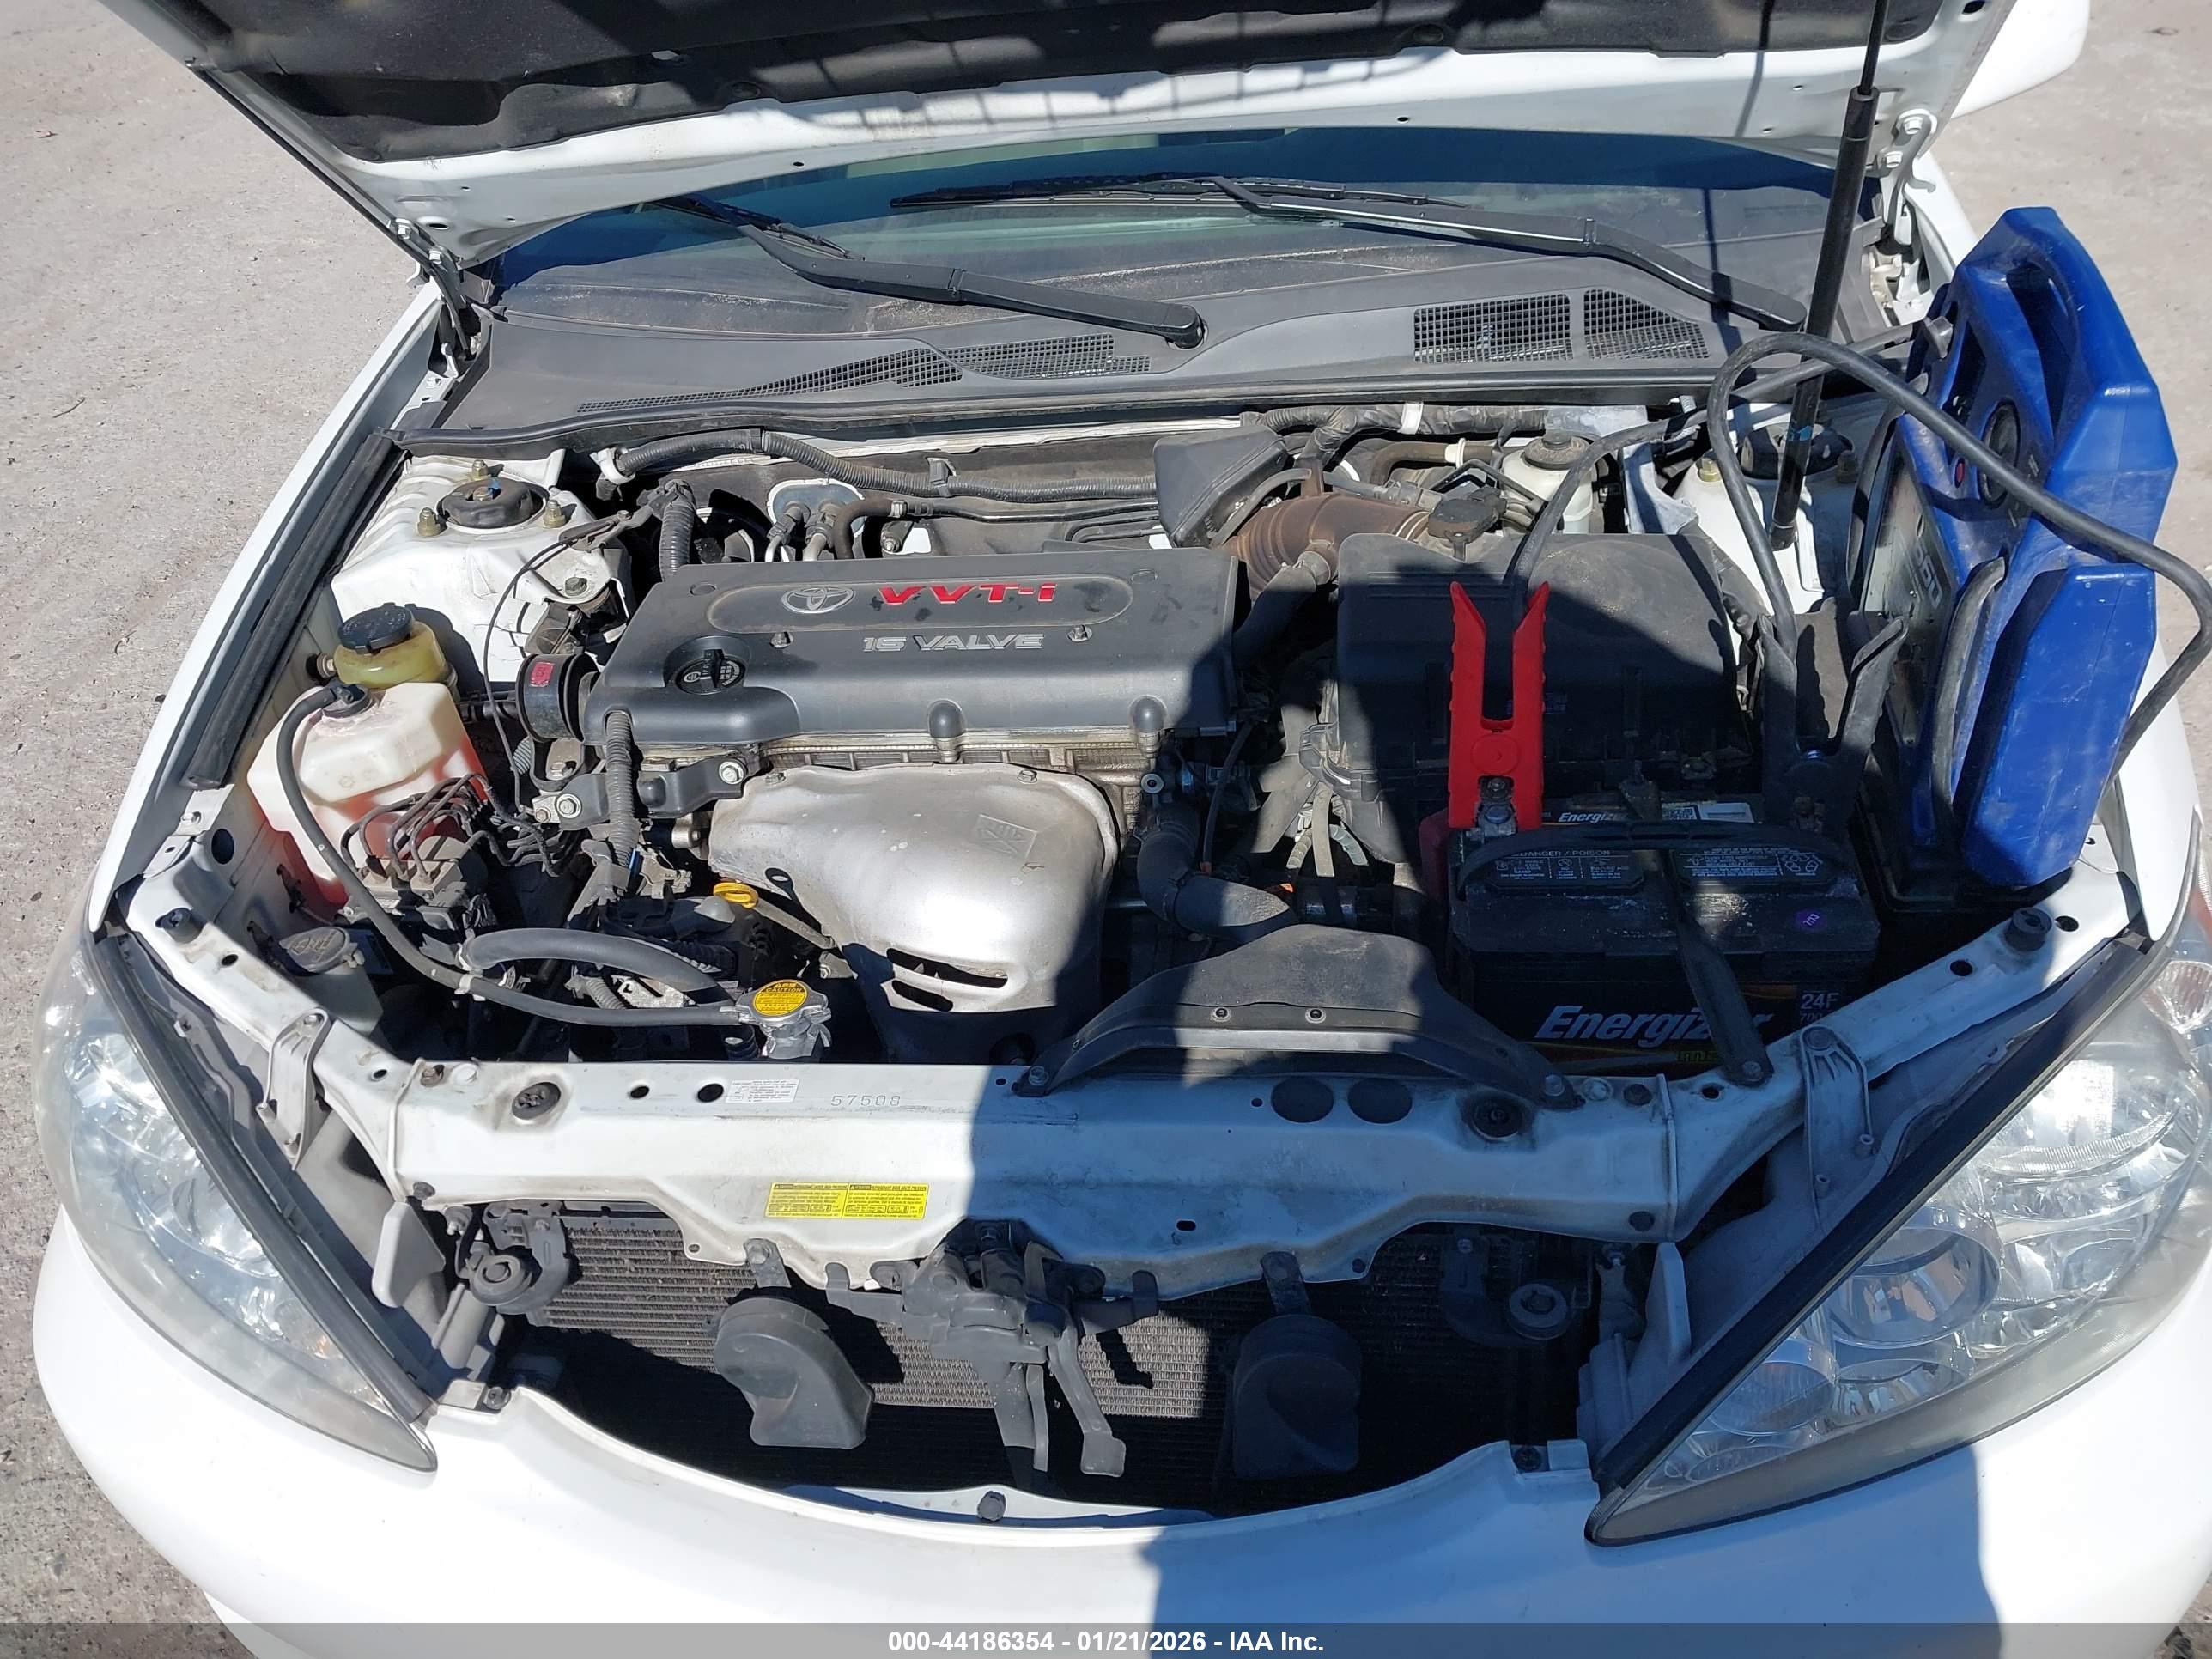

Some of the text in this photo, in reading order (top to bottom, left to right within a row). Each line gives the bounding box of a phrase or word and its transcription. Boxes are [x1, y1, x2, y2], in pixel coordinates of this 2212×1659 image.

[863, 633, 1045, 652] 16 VALVE
[1557, 811, 1629, 823] Energize
[1800, 992, 1840, 1009] 24F
[1534, 1004, 1775, 1048] Energizr
[830, 1094, 902, 1107] 57508
